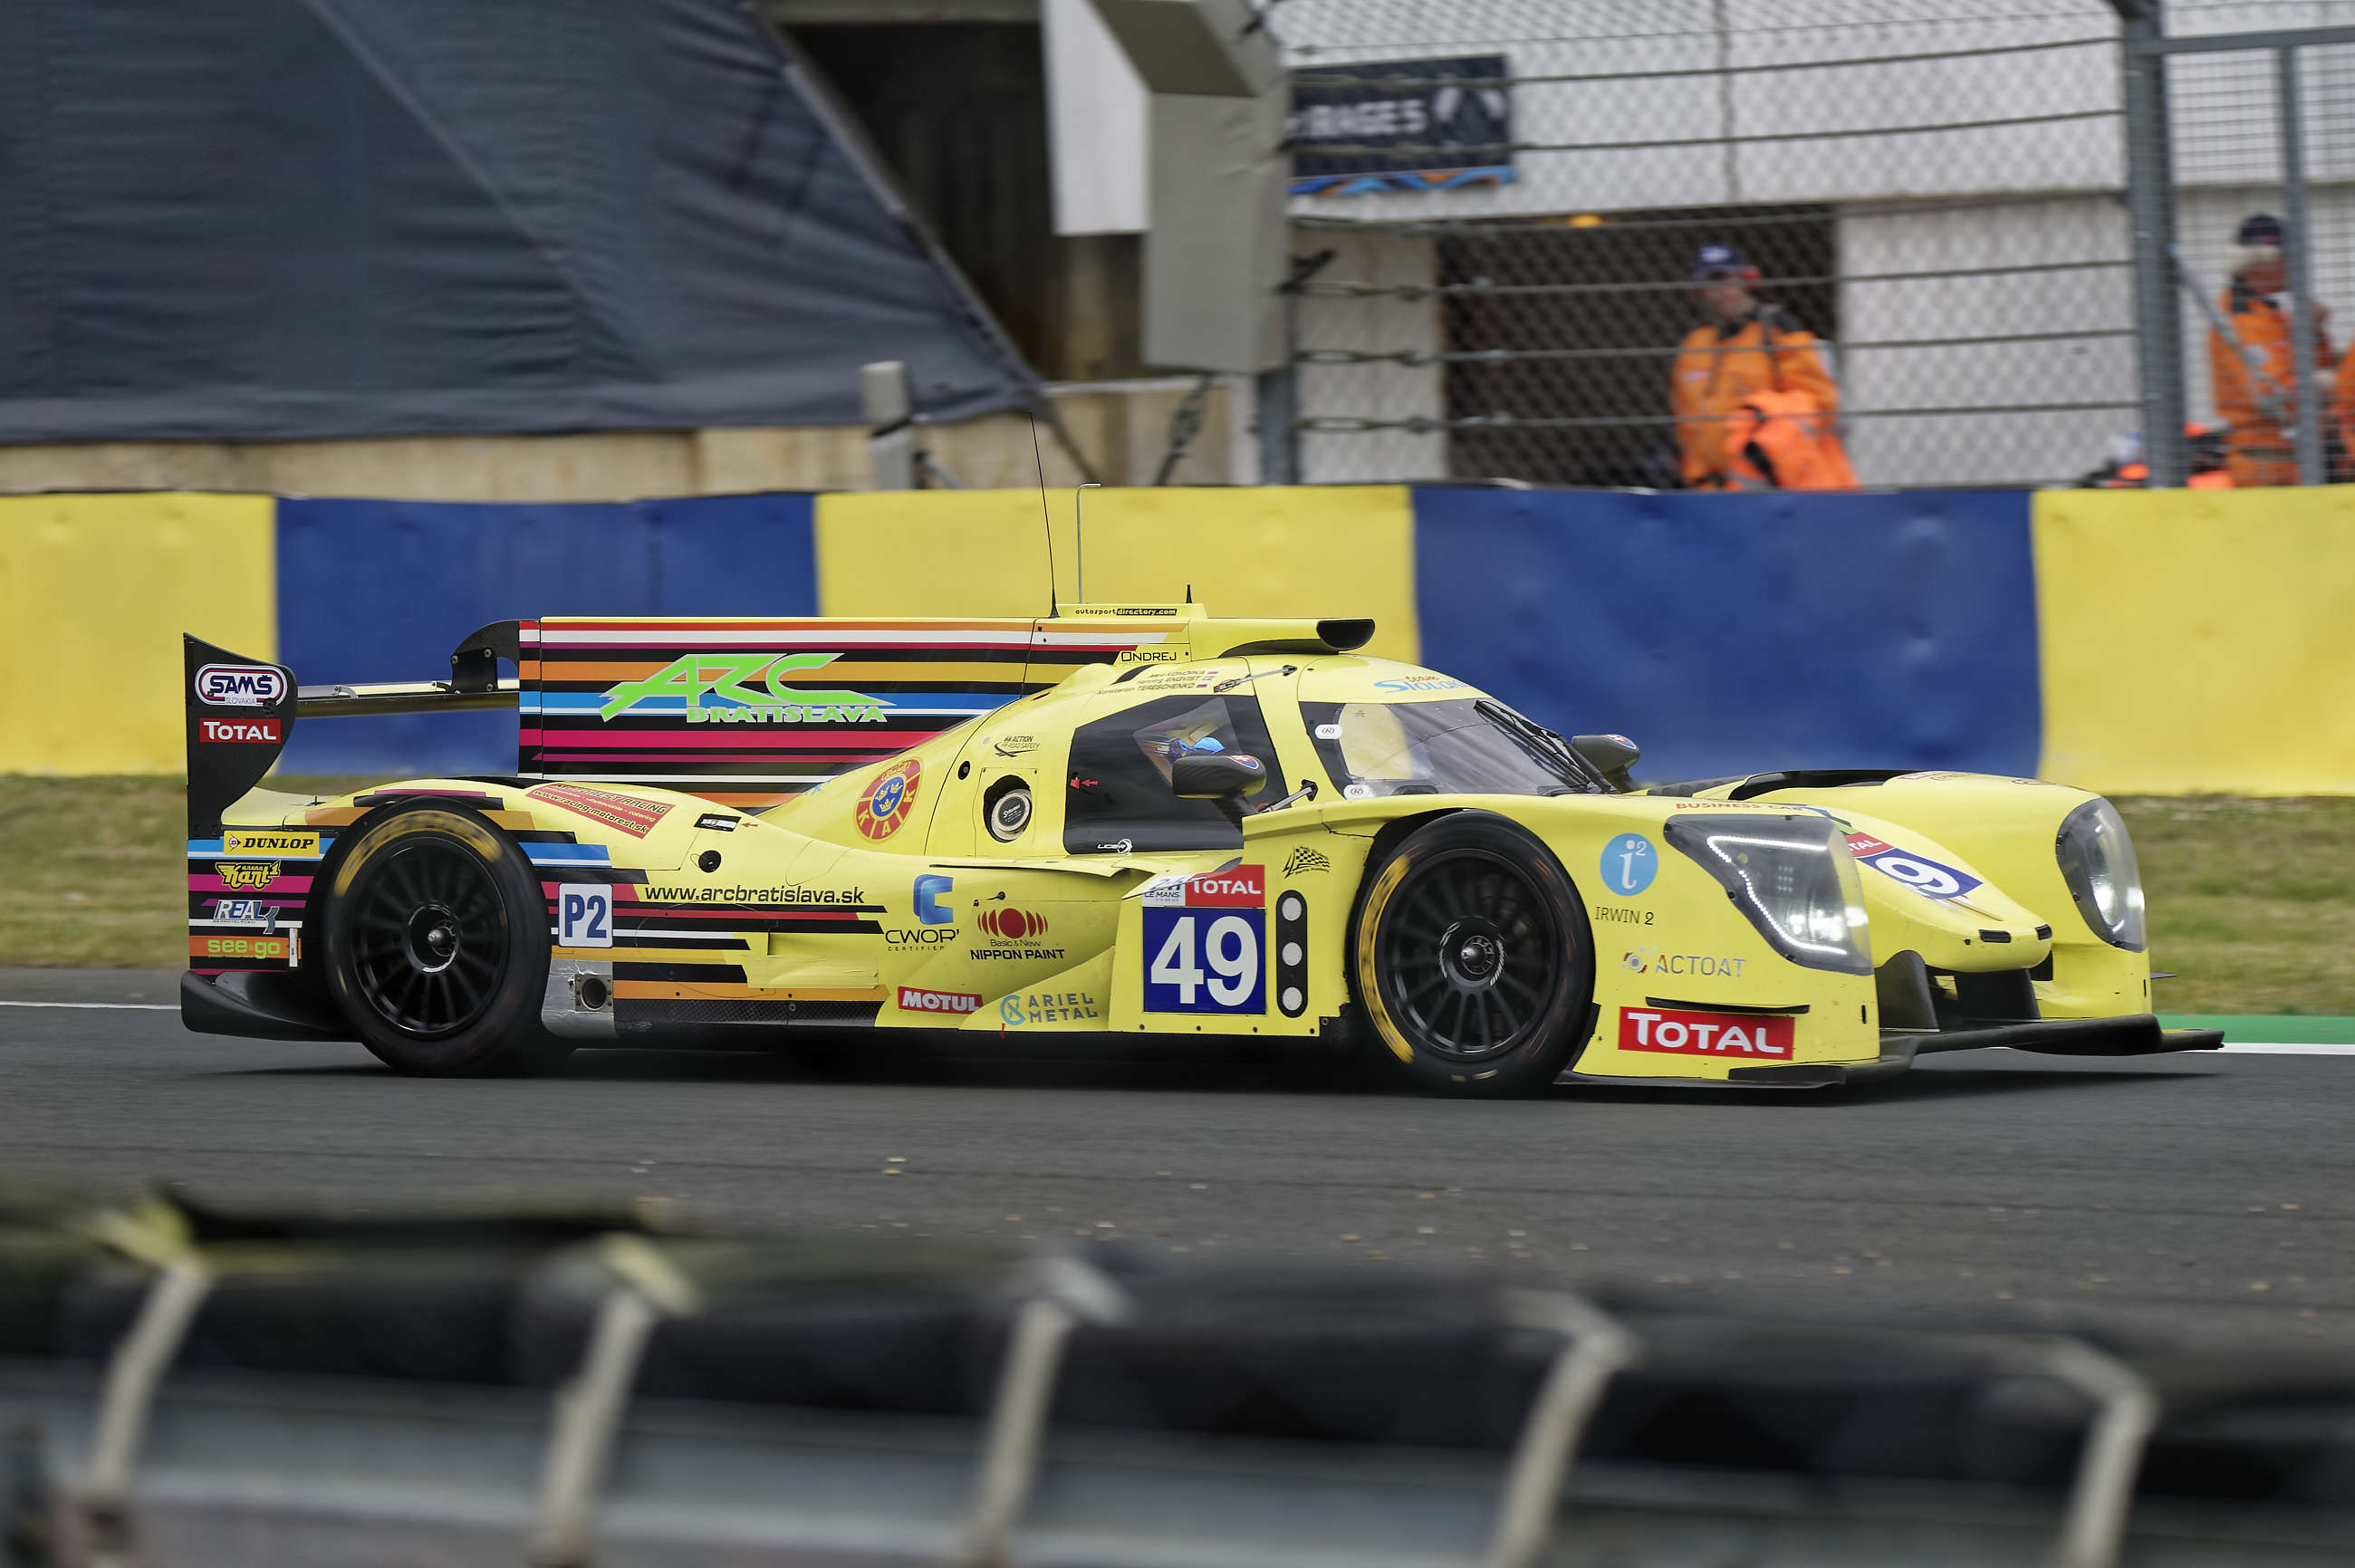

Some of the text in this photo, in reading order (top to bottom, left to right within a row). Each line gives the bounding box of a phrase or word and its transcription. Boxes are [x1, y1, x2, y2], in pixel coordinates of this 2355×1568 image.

[1121, 651, 1177, 662] ONDREJ
[209, 674, 273, 696] SAMŠ
[599, 652, 898, 723] ARC
[225, 697, 255, 705] SLOVAKIA
[686, 706, 888, 724] BRATISLAVA
[203, 720, 277, 741] TOTAL
[621, 797, 671, 815] RACING
[243, 838, 314, 850] DUNLOP
[644, 885, 865, 904] www.arcbratislava.sk
[1193, 879, 1262, 895] TOTAL
[564, 893, 607, 939] P2
[1594, 907, 1655, 926] IRWIN 2
[990, 938, 1013, 948] Basic
[1019, 938, 1042, 948] New
[970, 948, 1065, 960] NIPPON PAINT
[1150, 915, 1259, 1007] 49
[1654, 953, 1747, 978] ACTOAT
[901, 990, 980, 1012] MOTUL
[1028, 992, 1094, 1008] ARIEL
[1029, 1006, 1099, 1024] METAL
[1627, 1012, 1785, 1054] TOTAL
